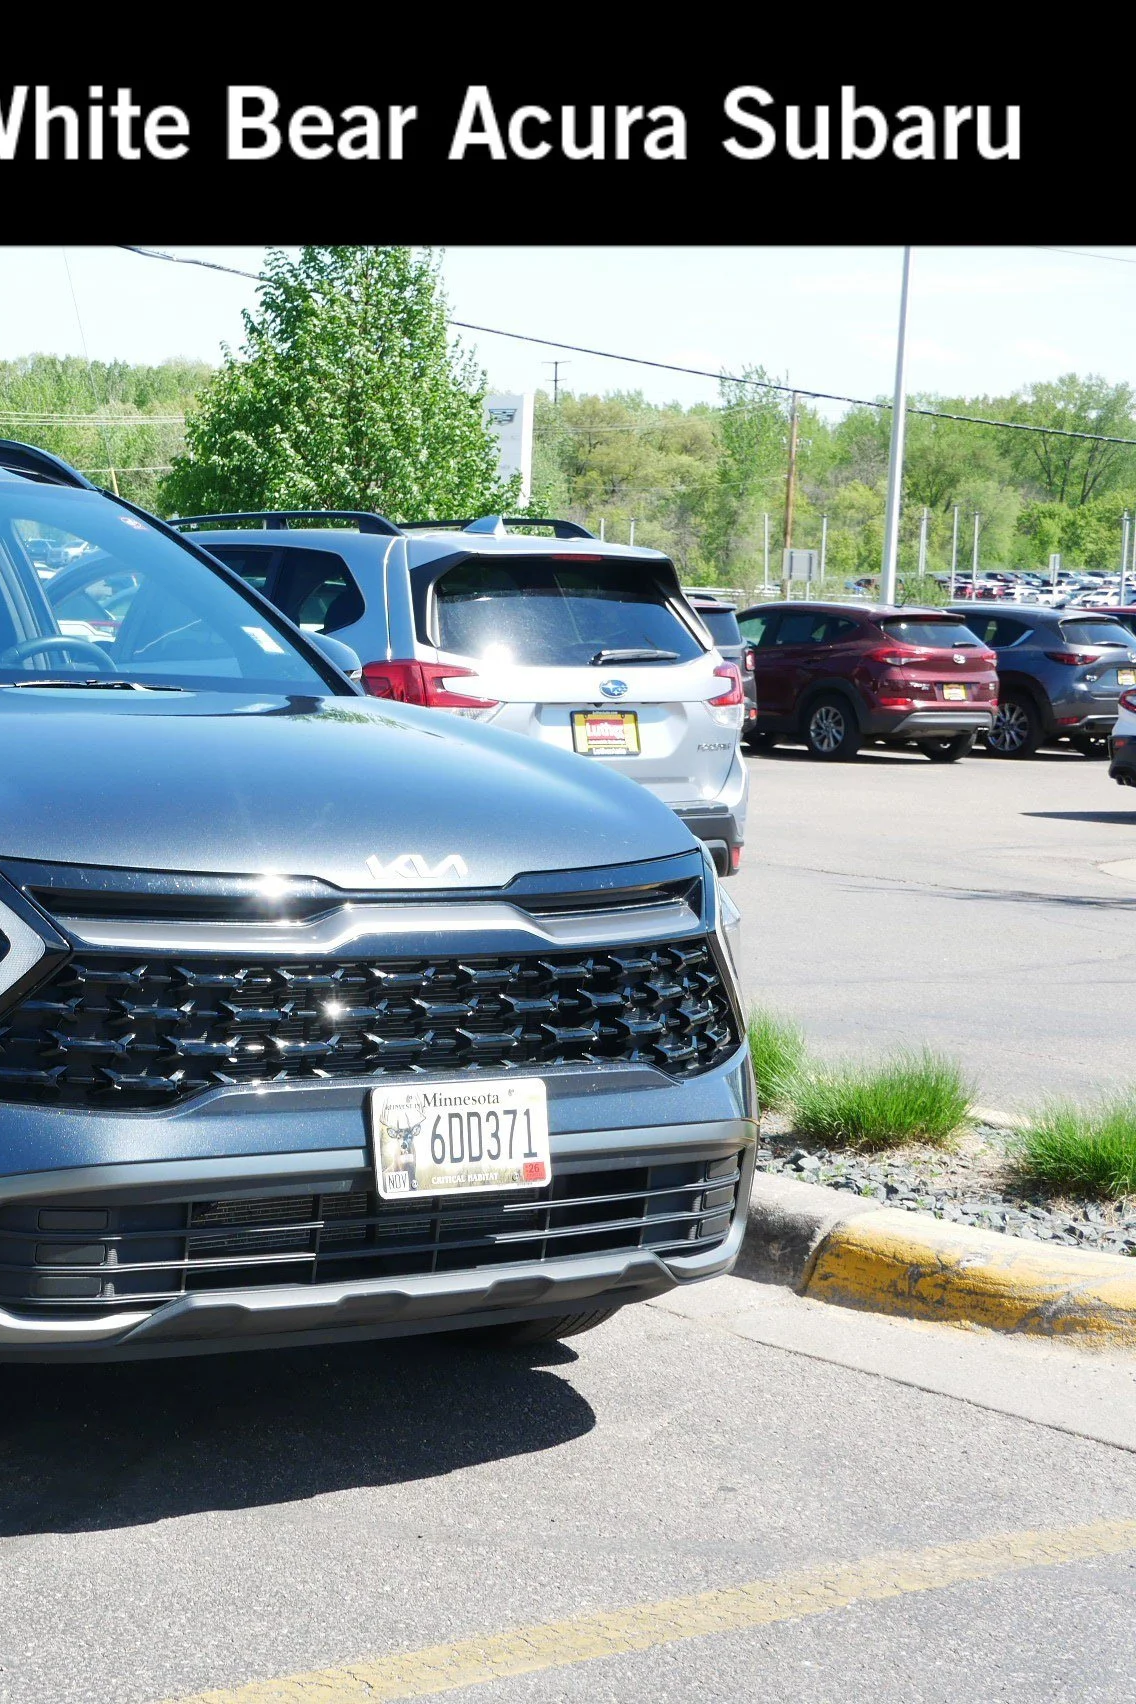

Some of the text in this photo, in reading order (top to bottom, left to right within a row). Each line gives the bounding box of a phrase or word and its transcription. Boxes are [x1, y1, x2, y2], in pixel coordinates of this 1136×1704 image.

[422, 1092, 501, 1108] Minnesota
[430, 1108, 538, 1165] 6DD371
[528, 1163, 540, 1173] 26
[388, 1173, 408, 1190] NOV
[431, 1172, 499, 1185] CRITICAL HABITAT
